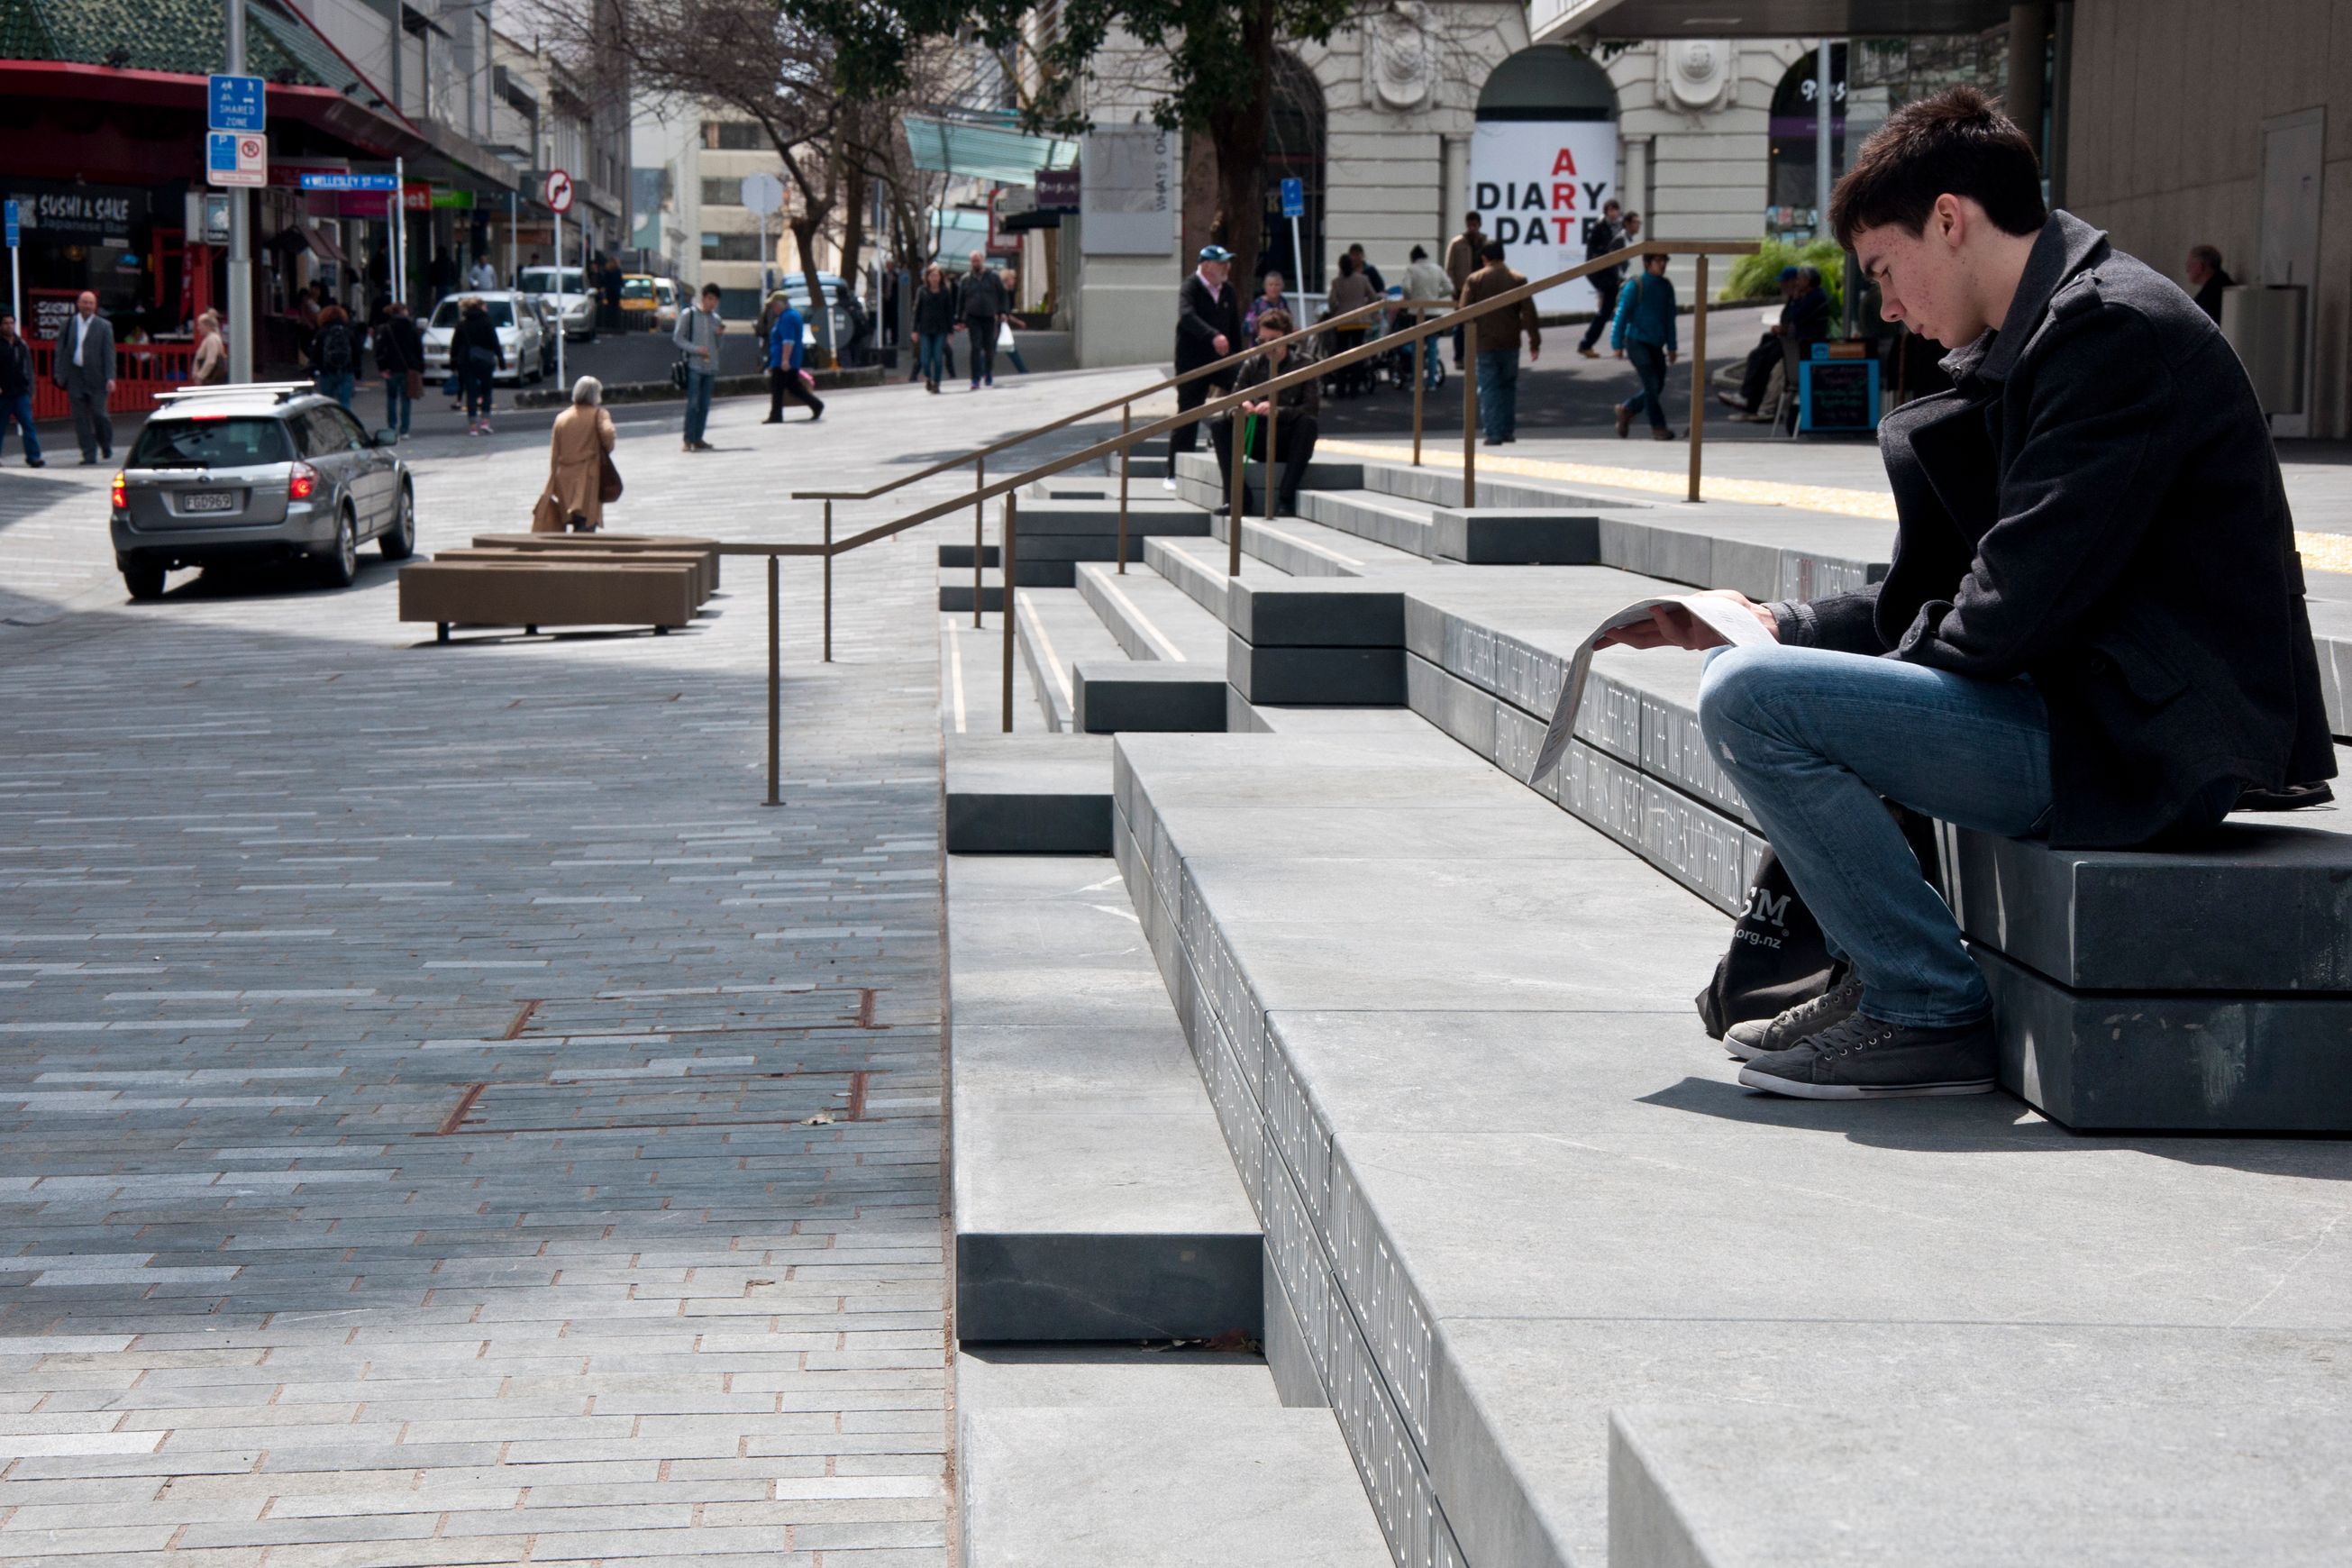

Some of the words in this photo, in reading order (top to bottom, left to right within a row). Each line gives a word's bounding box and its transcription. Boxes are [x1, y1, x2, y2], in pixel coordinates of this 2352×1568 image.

[219, 105, 256, 115] SHARED
[225, 117, 248, 127] ZONE
[312, 177, 359, 188] WELLESLEY
[361, 177, 371, 187] ST
[1476, 182, 1607, 211] DIARY
[39, 194, 82, 218] SUSHI
[84, 199, 93, 218] &
[95, 197, 130, 221] SAKE
